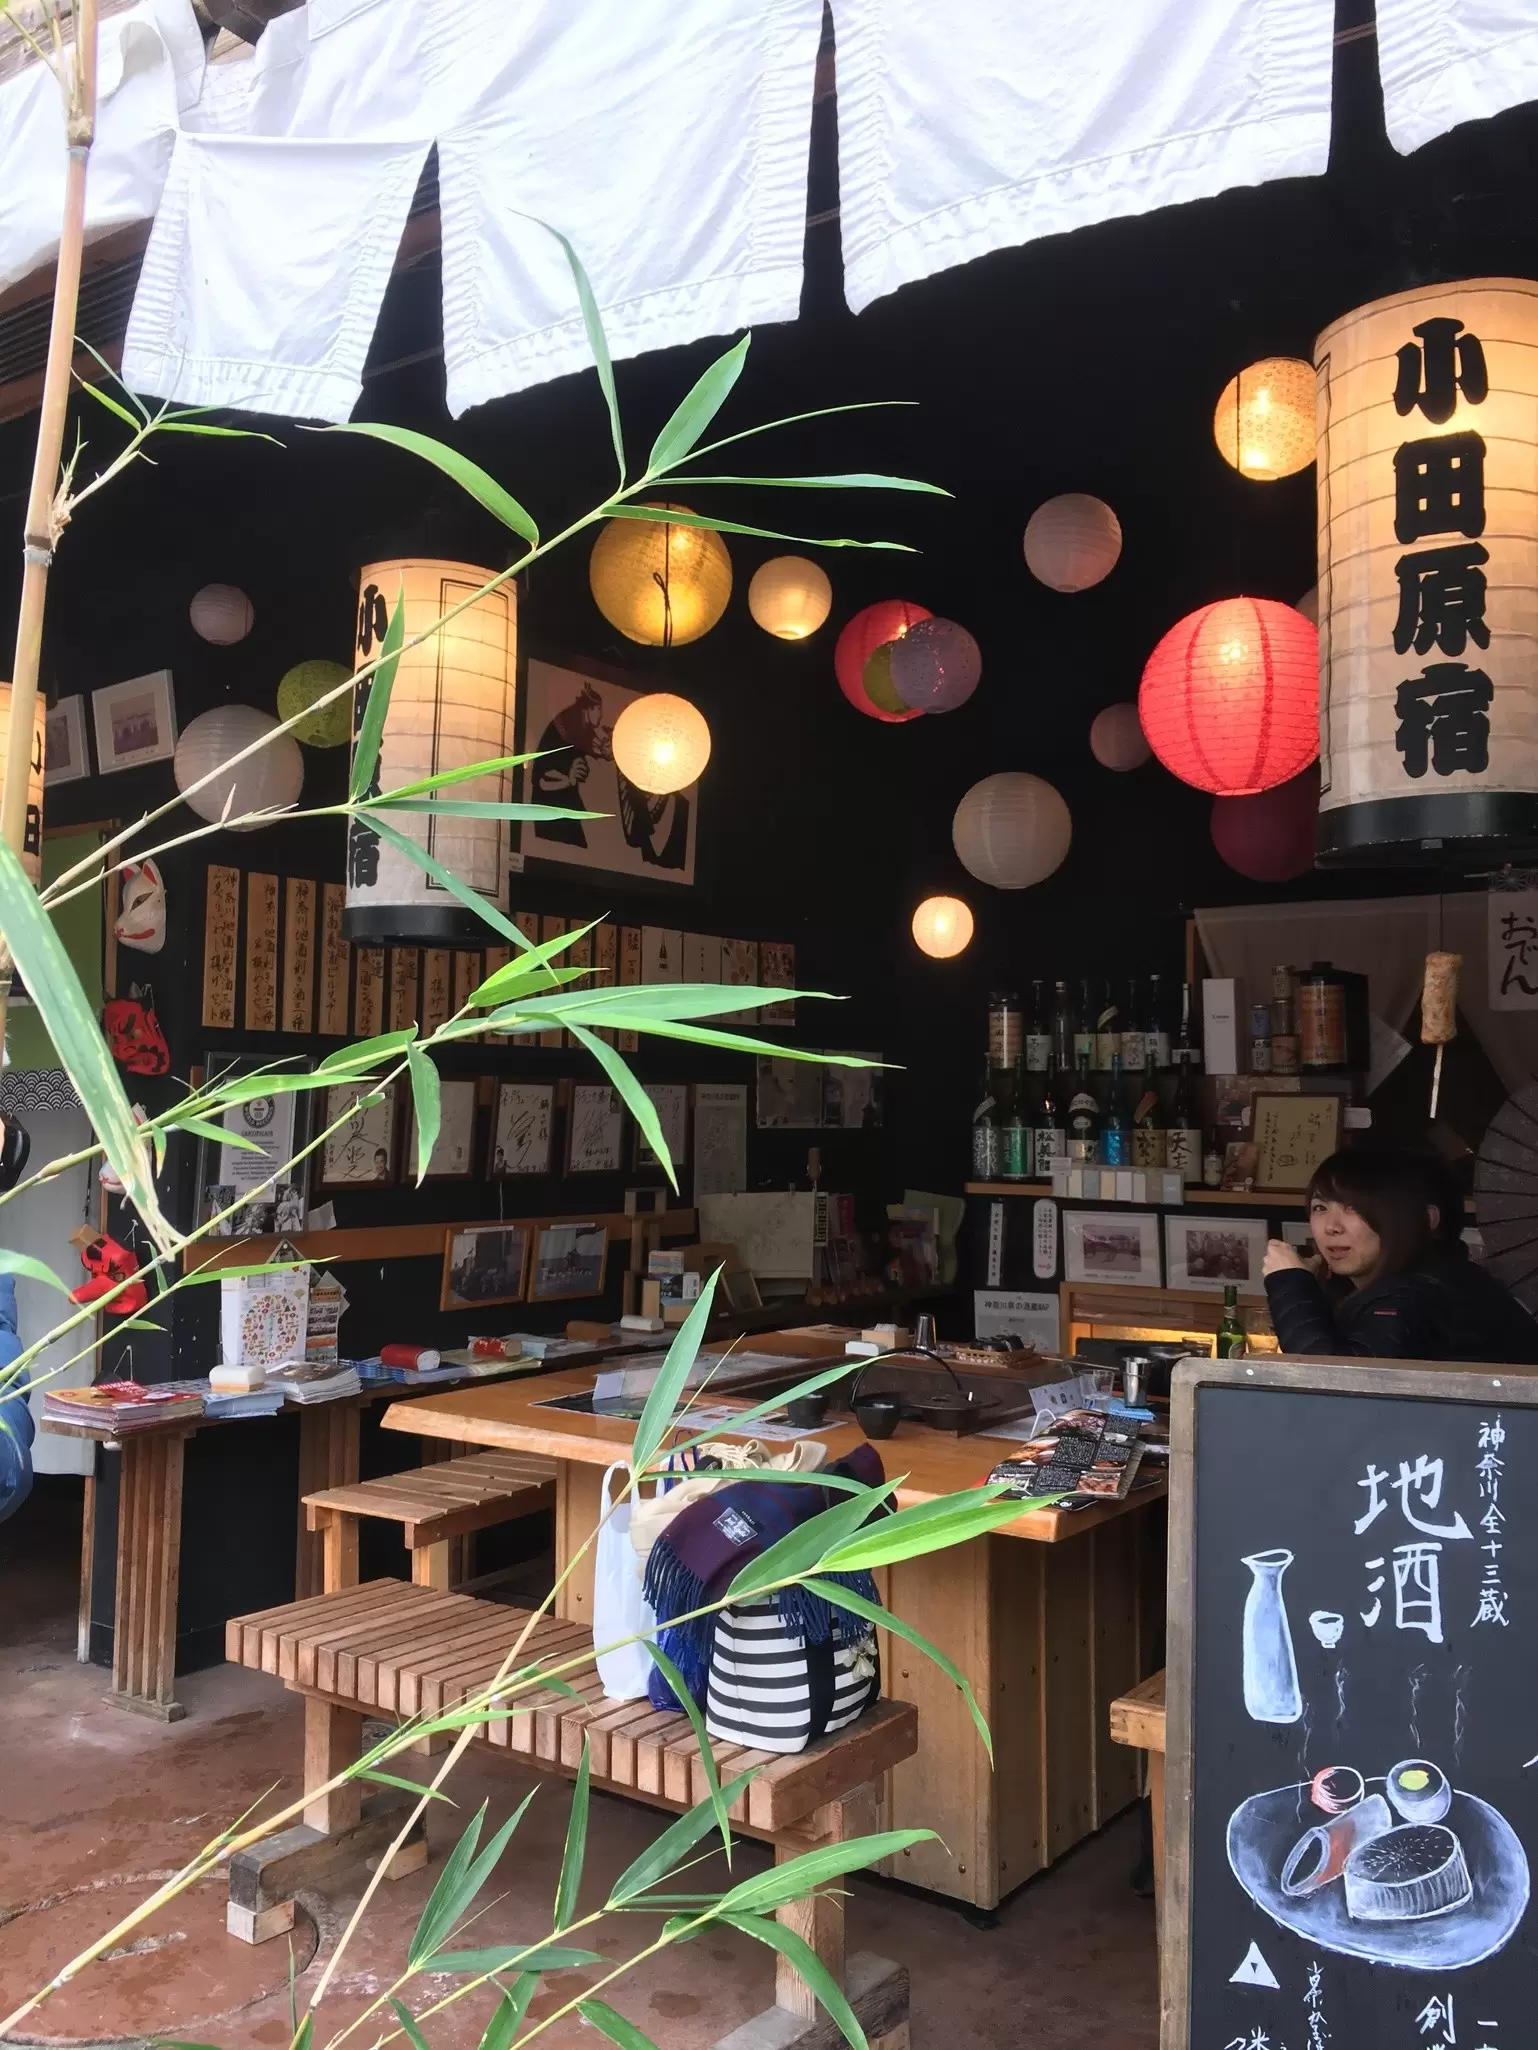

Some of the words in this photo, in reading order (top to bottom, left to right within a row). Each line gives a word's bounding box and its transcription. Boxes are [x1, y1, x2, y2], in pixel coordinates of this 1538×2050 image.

[1391, 316, 1495, 779] 小田原宿
[1501, 911, 1538, 995] おでん
[1354, 1453, 1474, 1644] 地酒
[1470, 1416, 1509, 1627] 神奈川全十三蔵
[1415, 1992, 1457, 2050] 創
